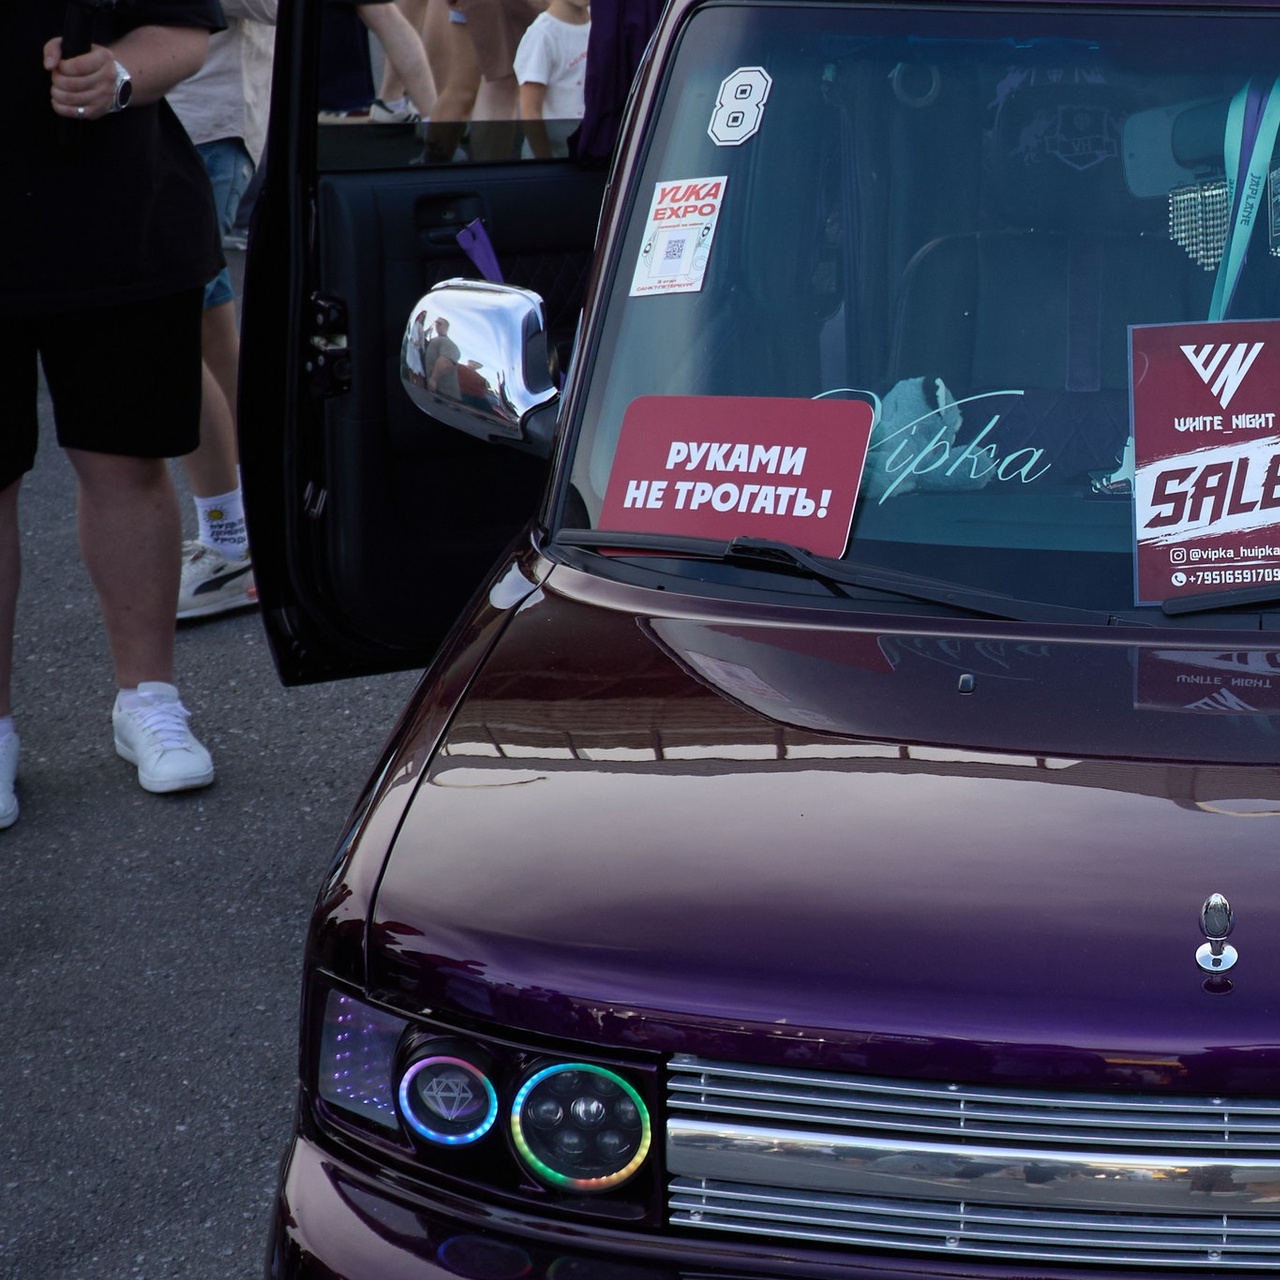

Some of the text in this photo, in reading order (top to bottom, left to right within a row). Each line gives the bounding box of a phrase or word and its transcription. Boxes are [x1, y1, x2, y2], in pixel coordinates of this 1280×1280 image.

[707, 66, 773, 146] 8
[657, 182, 722, 205] YUKA
[653, 203, 716, 221] EXPO
[1174, 413, 1276, 434] WHITE_NIGHT
[665, 441, 808, 476] РУКАМИ
[622, 480, 832, 519] НЕ ТРОГАТЬ!
[1190, 545, 1280, 561] @vipka_huipka
[1188, 568, 1280, 585] +79516591709
